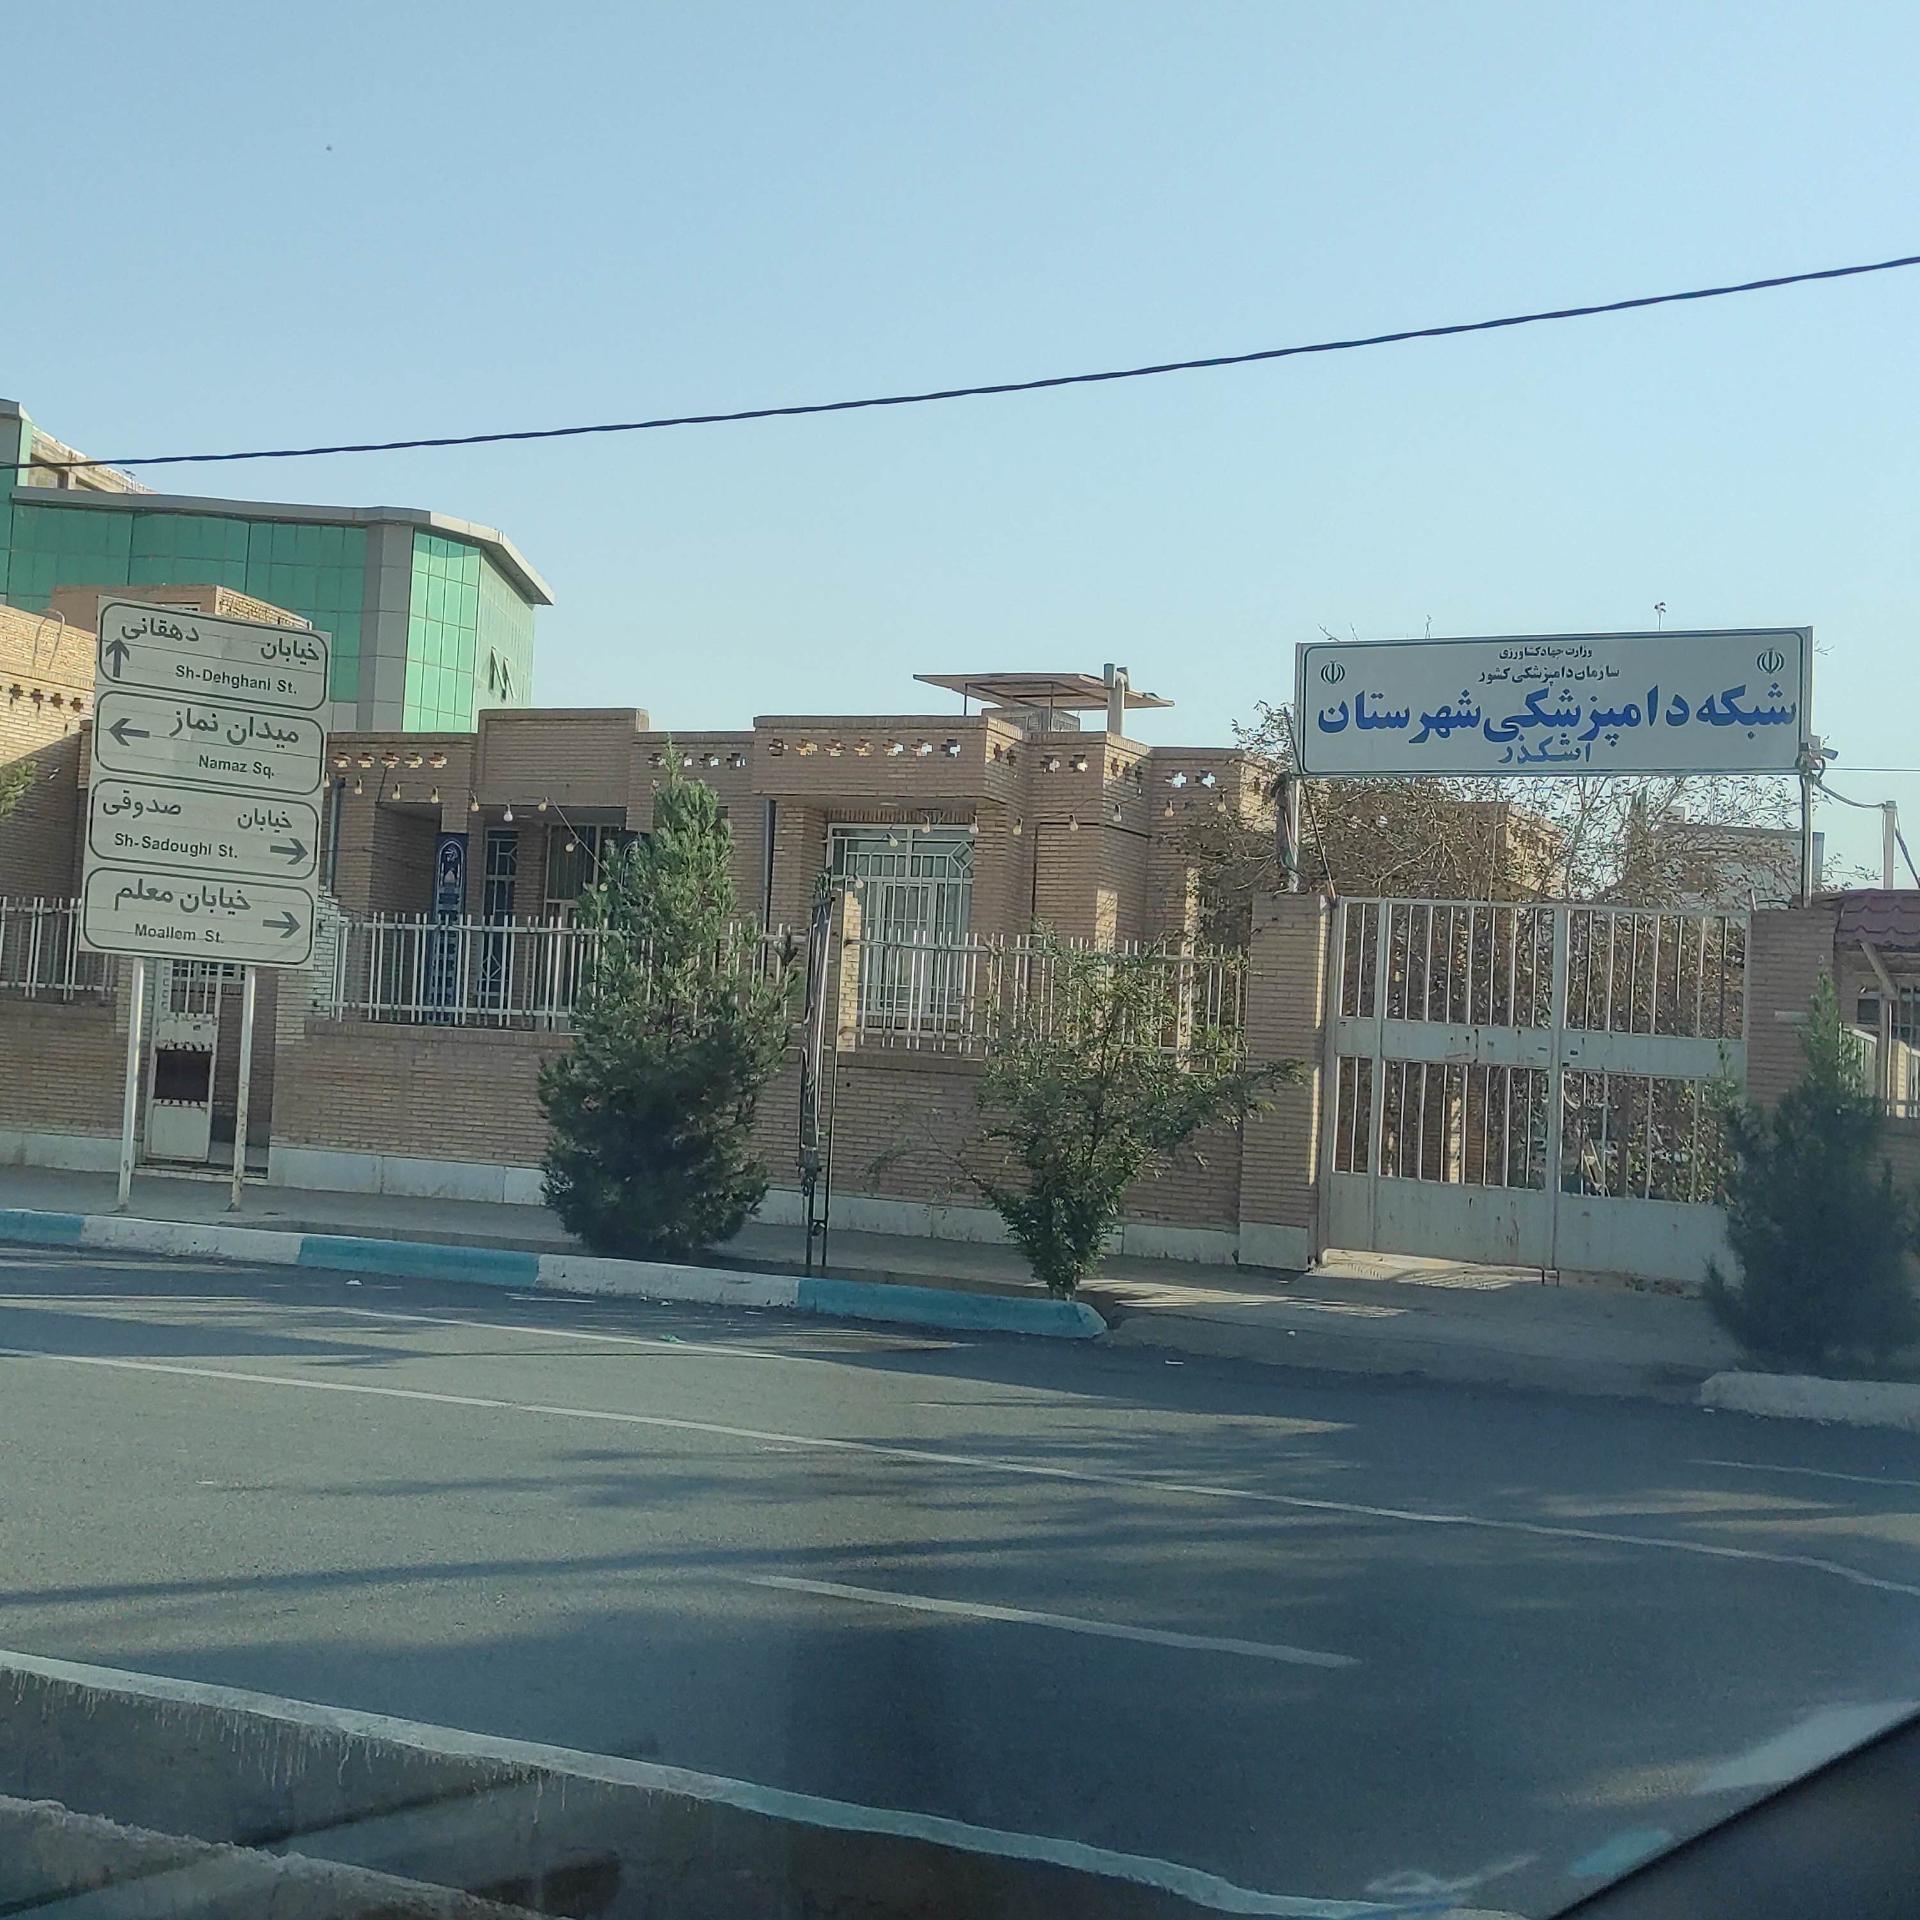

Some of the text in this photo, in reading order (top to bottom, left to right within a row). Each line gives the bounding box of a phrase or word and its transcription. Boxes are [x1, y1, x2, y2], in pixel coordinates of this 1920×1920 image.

[121, 617, 320, 665] خیابان دهقانی
[1565, 645, 1593, 658] وزارت
[176, 664, 298, 694] Sh-Dehghani St.
[1478, 667, 1511, 684] کشور
[1575, 665, 1620, 681] سازمان
[168, 708, 299, 749] میدان نماز
[1317, 682, 1797, 747] شبکه دامپزشکی شهرستان
[1498, 732, 1592, 764] اشکذر
[199, 754, 275, 779] Namaz Sq.
[102, 789, 293, 833] خیابان صدوقی
[114, 832, 238, 859] Sh-Sadoughi St.
[114, 878, 251, 915] خیابان معلم
[134, 923, 225, 943] Moallem St.
